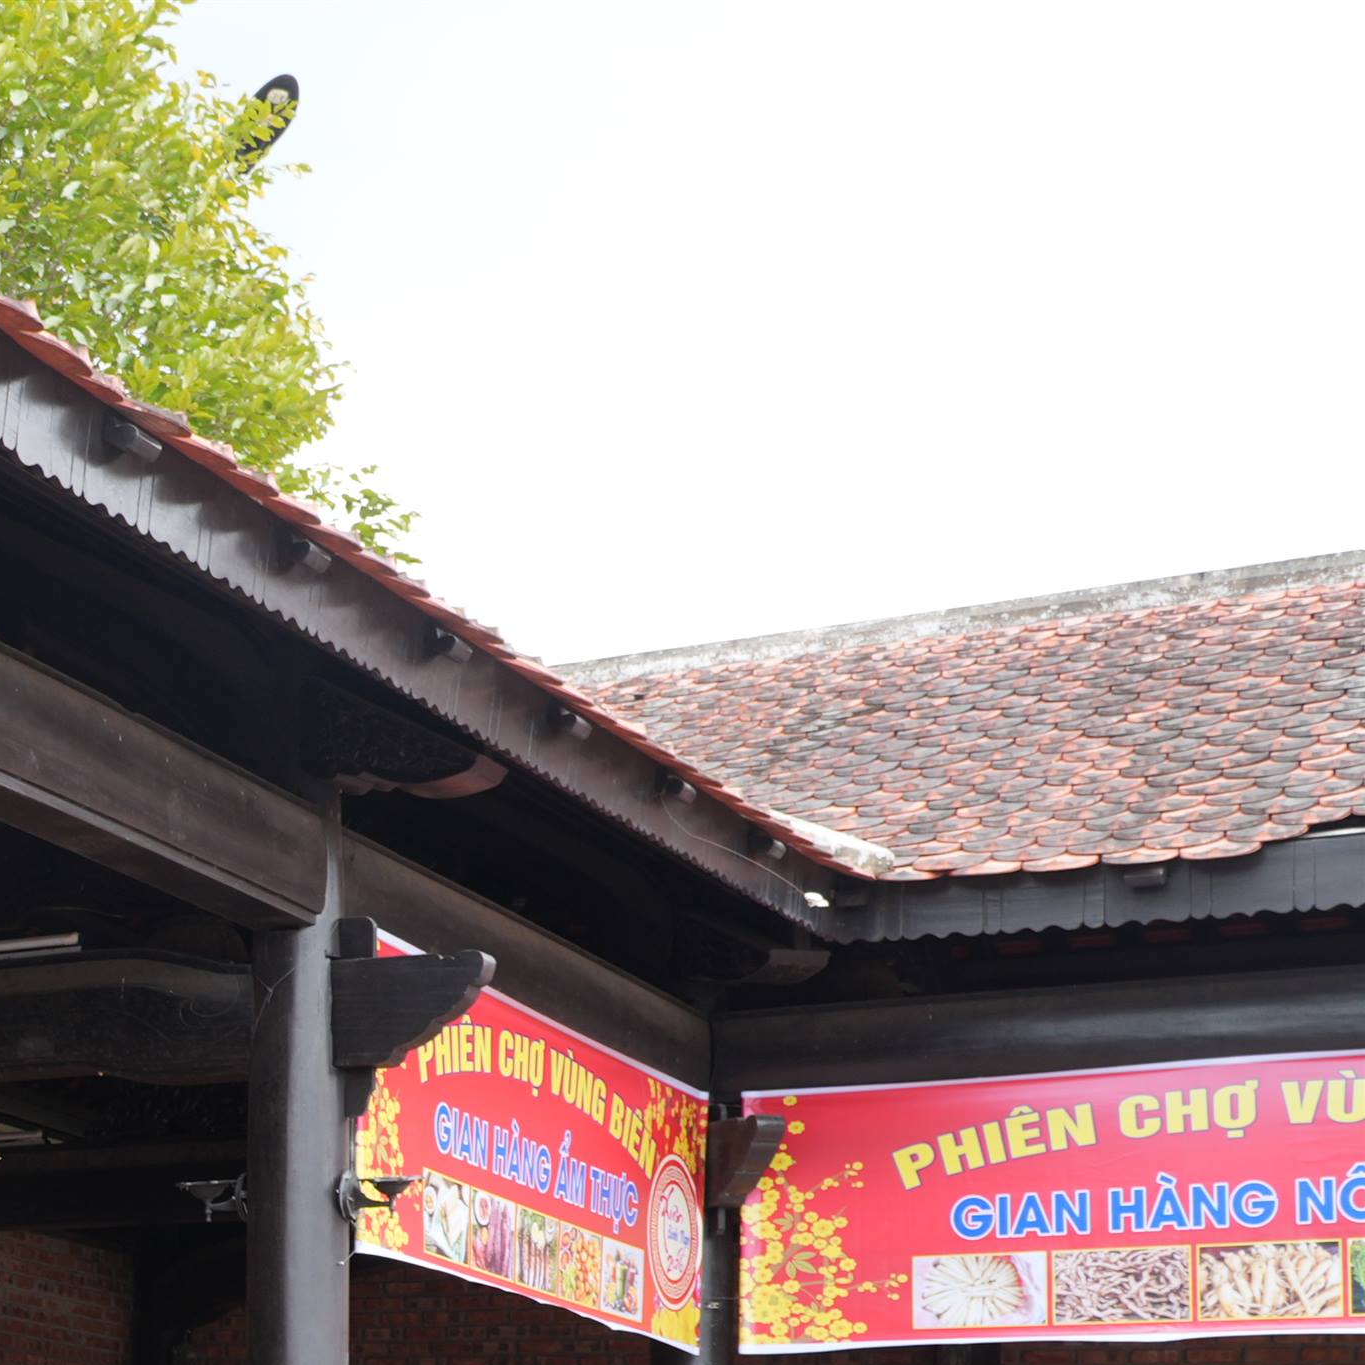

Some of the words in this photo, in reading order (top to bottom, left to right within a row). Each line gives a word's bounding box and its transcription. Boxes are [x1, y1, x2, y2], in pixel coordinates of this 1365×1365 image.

[417, 1014, 492, 1084] PHIÊN
[498, 1029, 546, 1097] CHỢ
[550, 1048, 607, 1126] VÙNG
[609, 1091, 657, 1180] BIÊN
[891, 1102, 1099, 1192] PHIÊN
[1117, 1077, 1259, 1139] CHỢ
[434, 1102, 489, 1170] GIAN
[493, 1118, 552, 1194] HÀNG
[554, 1130, 586, 1209] ẨM
[590, 1166, 639, 1234] THỰC
[951, 1189, 1093, 1241] GIAN
[1108, 1172, 1279, 1235] HÀNG
